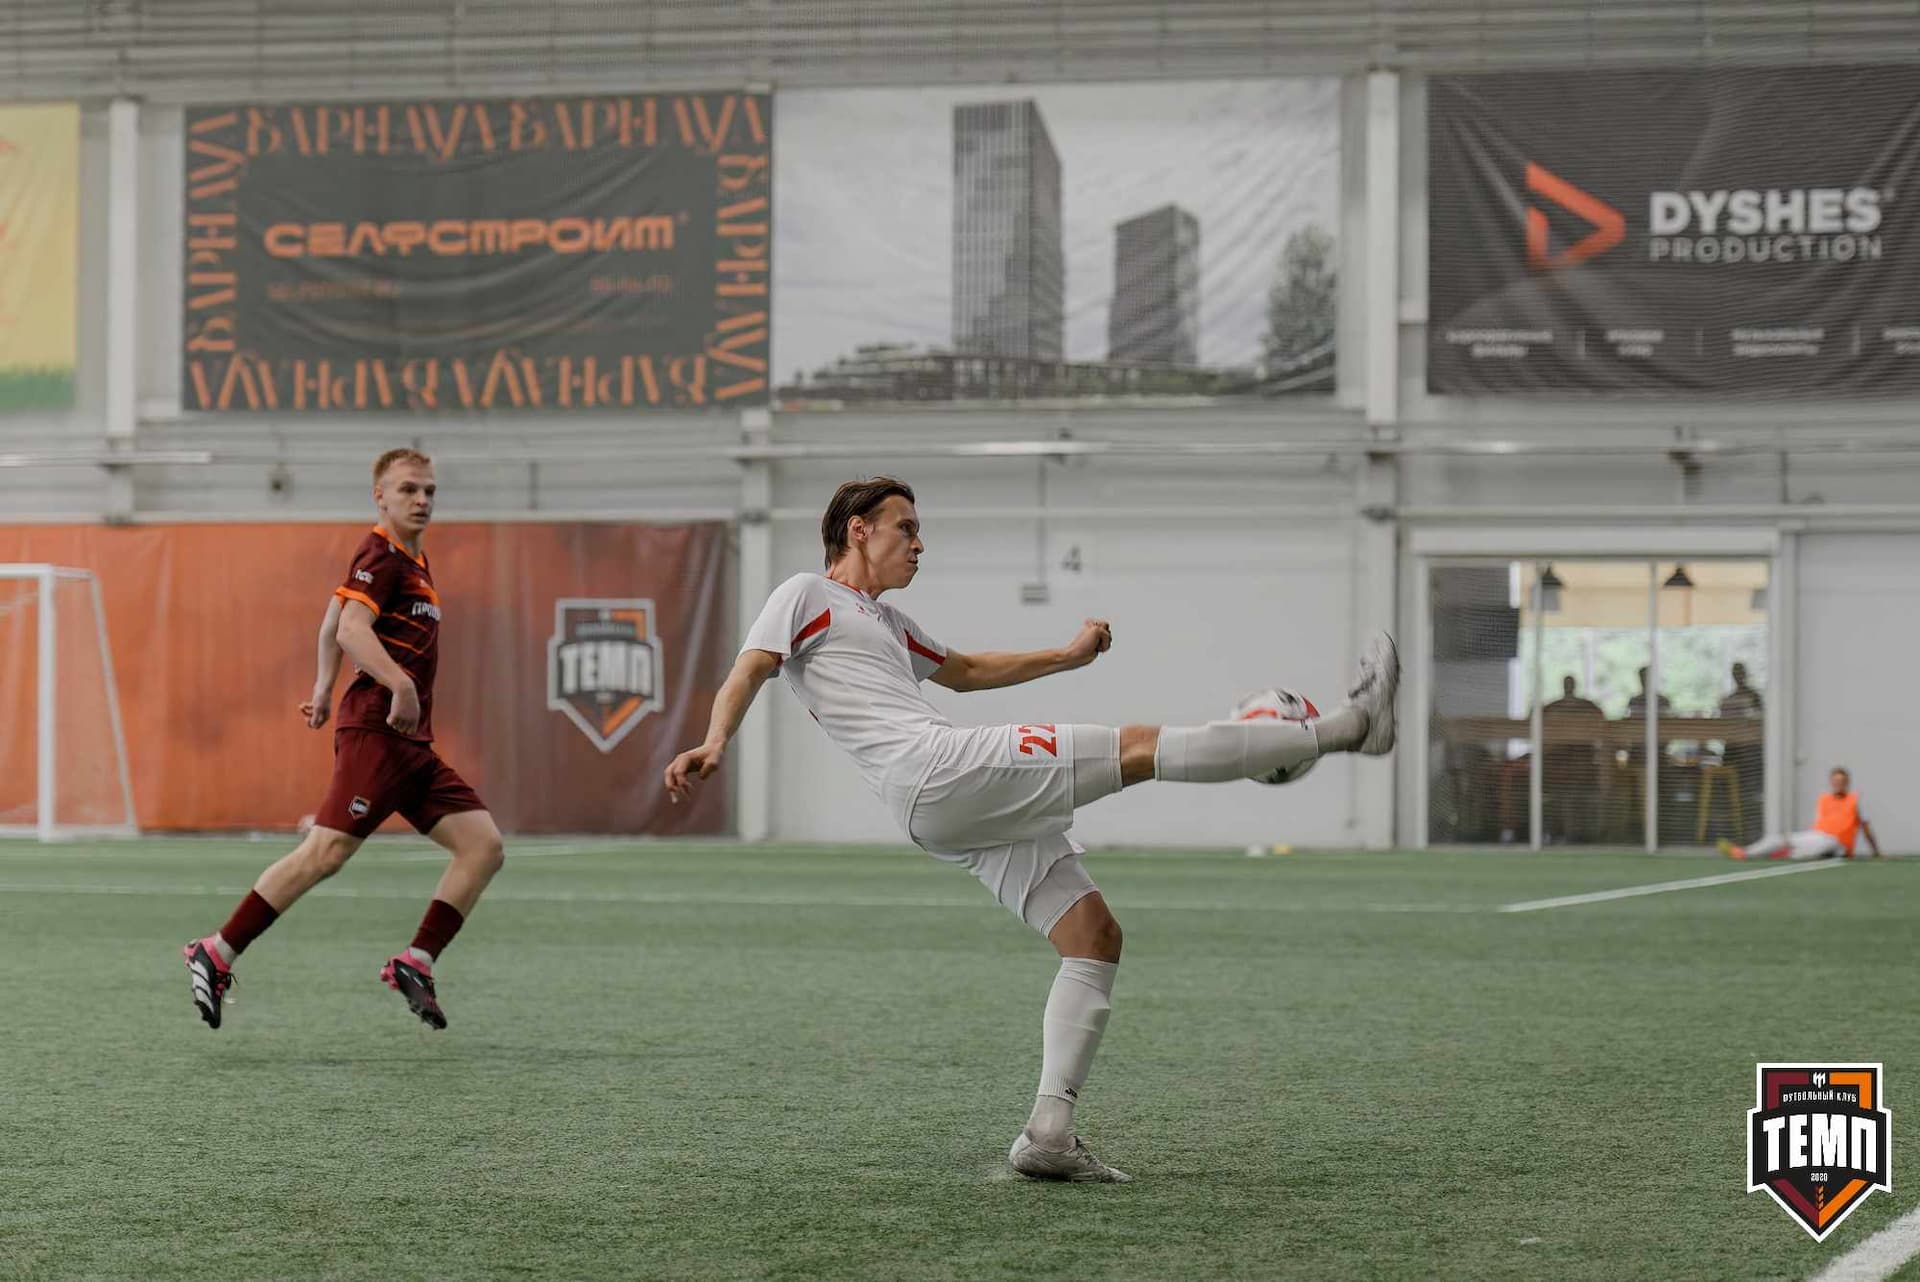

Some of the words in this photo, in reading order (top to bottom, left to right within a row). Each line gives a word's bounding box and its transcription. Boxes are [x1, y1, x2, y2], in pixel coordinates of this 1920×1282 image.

[1650, 187, 1882, 235] DYSHES
[1650, 233, 1882, 264] PRODUCTION
[557, 640, 654, 696] ТЕМП
